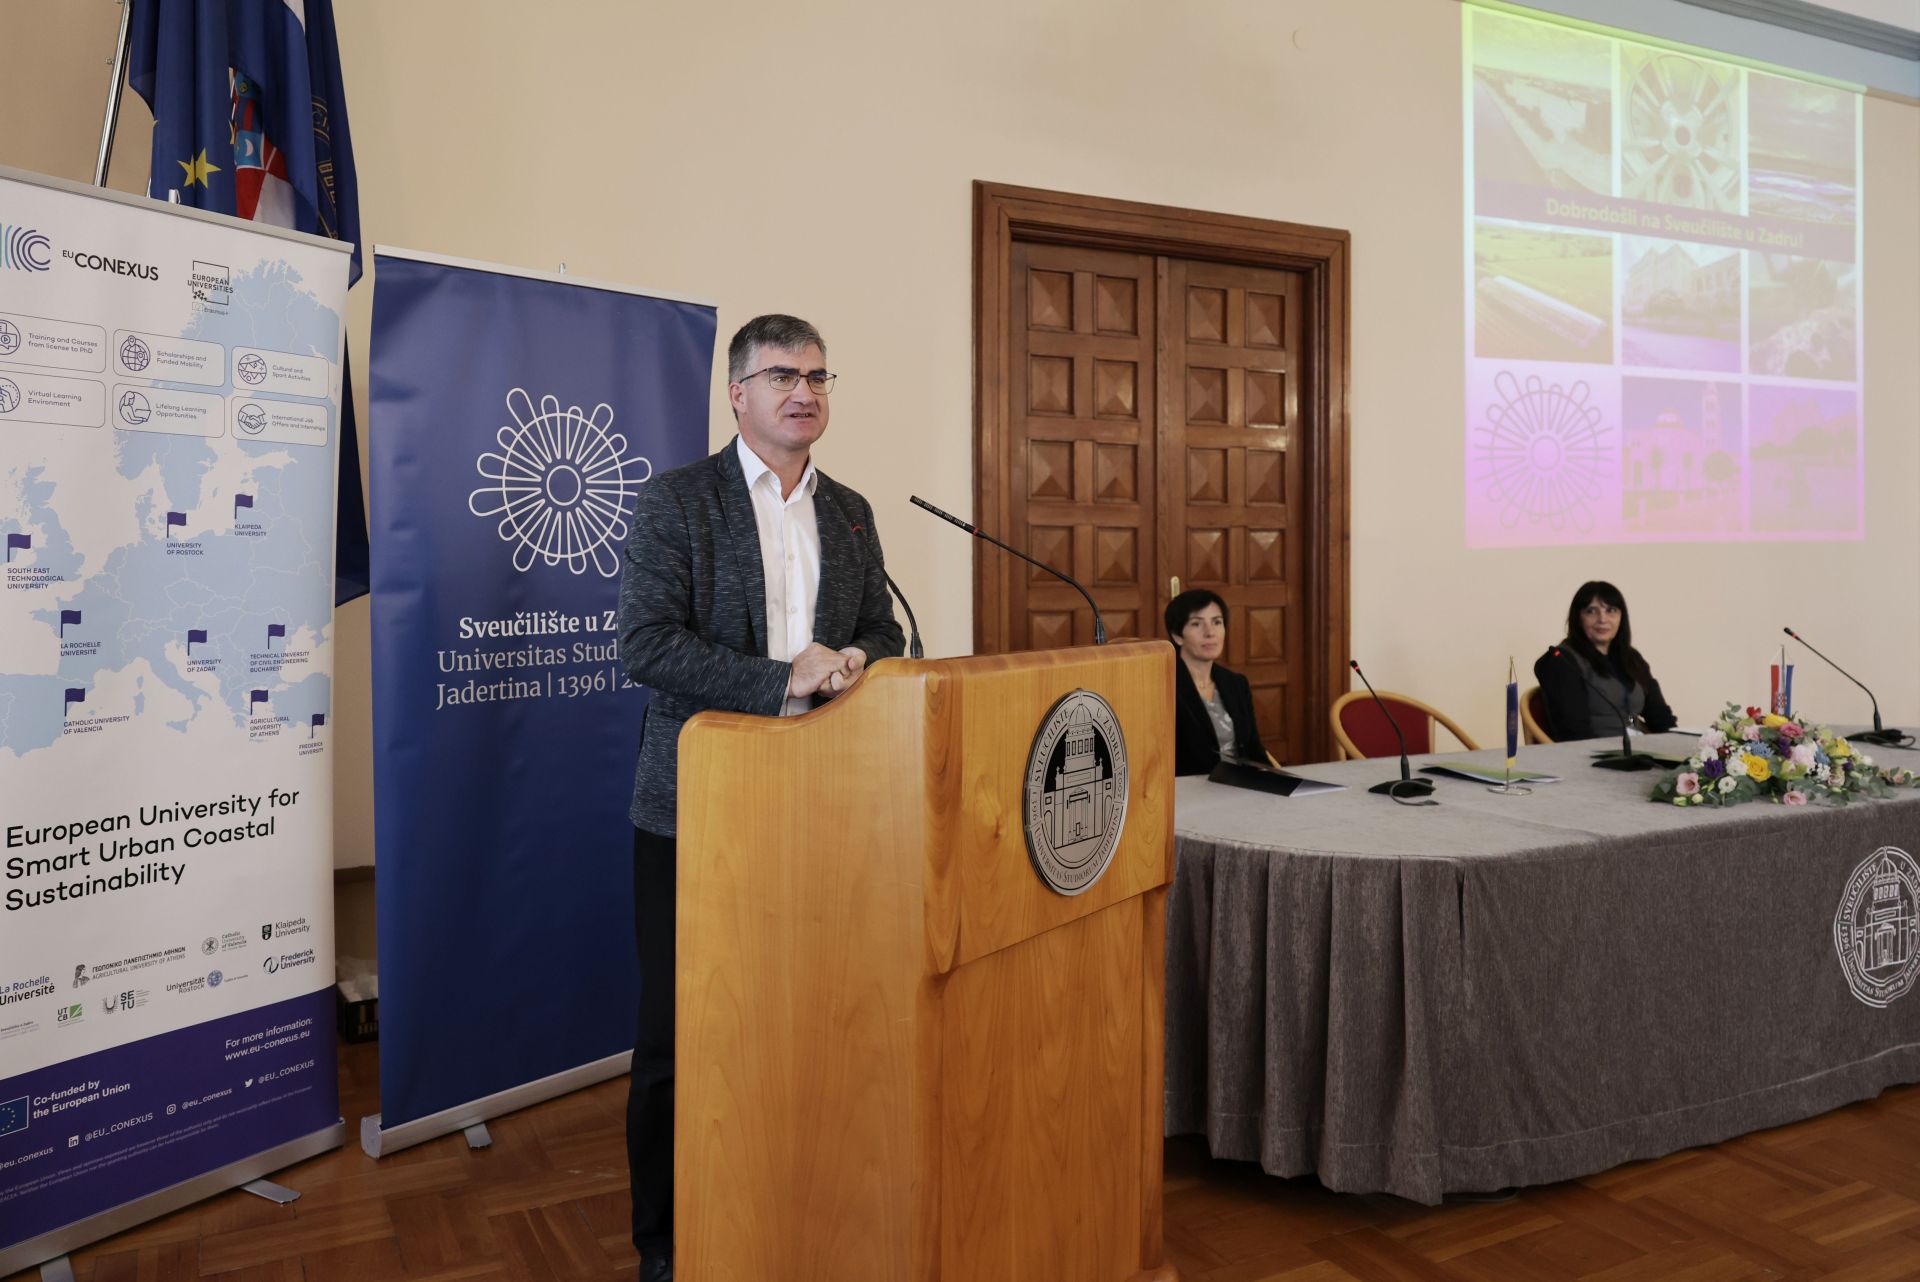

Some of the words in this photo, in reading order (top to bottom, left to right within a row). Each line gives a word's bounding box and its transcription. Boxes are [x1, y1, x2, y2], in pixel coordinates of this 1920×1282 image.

[1546, 197, 1638, 227] Dobrodošli
[1642, 215, 1660, 230] na
[187, 280, 234, 293] UNIVERSITIES
[192, 273, 229, 286] EUROPEAN
[28, 332, 56, 344] Training
[56, 335, 70, 344] and
[71, 338, 98, 347] Courses
[46, 342, 69, 351] license
[79, 345, 93, 354] PhD
[28, 390, 52, 398] Virtual
[53, 391, 82, 402] Learning
[28, 397, 71, 407] Environment
[32, 567, 50, 575] EAST
[7, 582, 49, 590] UNIVERSITY
[459, 609, 580, 639] Sveučilište
[585, 616, 598, 631] u
[69, 641, 101, 649] ROCHELLE
[438, 644, 567, 673] Universitas
[196, 665, 216, 673] ZADAR
[436, 676, 541, 710] Jadertina
[558, 670, 606, 698] 1396
[63, 719, 93, 728] CATHOLIC
[94, 716, 130, 726] UNIVERSITY
[250, 716, 289, 724] AGRICULTURAL
[63, 728, 72, 736] OF
[73, 725, 103, 735] VALENCIA
[7, 814, 131, 848] European
[140, 794, 261, 827] University
[268, 788, 300, 808] for
[5, 847, 91, 880] Smart
[99, 835, 175, 862] Urban
[183, 816, 275, 849] Coastal
[5, 863, 186, 911] Sustainability
[275, 917, 306, 930] Klaipeda
[275, 924, 311, 938] University
[281, 948, 314, 962] Frederick
[281, 955, 316, 970] University
[129, 960, 158, 971] UNIVERSITY
[0, 986, 10, 995] La
[13, 975, 50, 991] Rochelle
[0, 982, 55, 1006] Université
[225, 1039, 240, 1049] For
[241, 1033, 263, 1046] more
[266, 1018, 313, 1037] information:
[224, 1029, 311, 1061] www.eu-conexus.eu
[258, 1059, 315, 1085] @EU_CONEXUS
[33, 1083, 81, 1106] Co-funded
[82, 1079, 101, 1095] by
[182, 1087, 232, 1110] @eu_conexus
[33, 1105, 50, 1119] the
[52, 1092, 100, 1113] European
[102, 1082, 131, 1101] Union
[84, 1112, 153, 1142] @EU_CONEXUS
